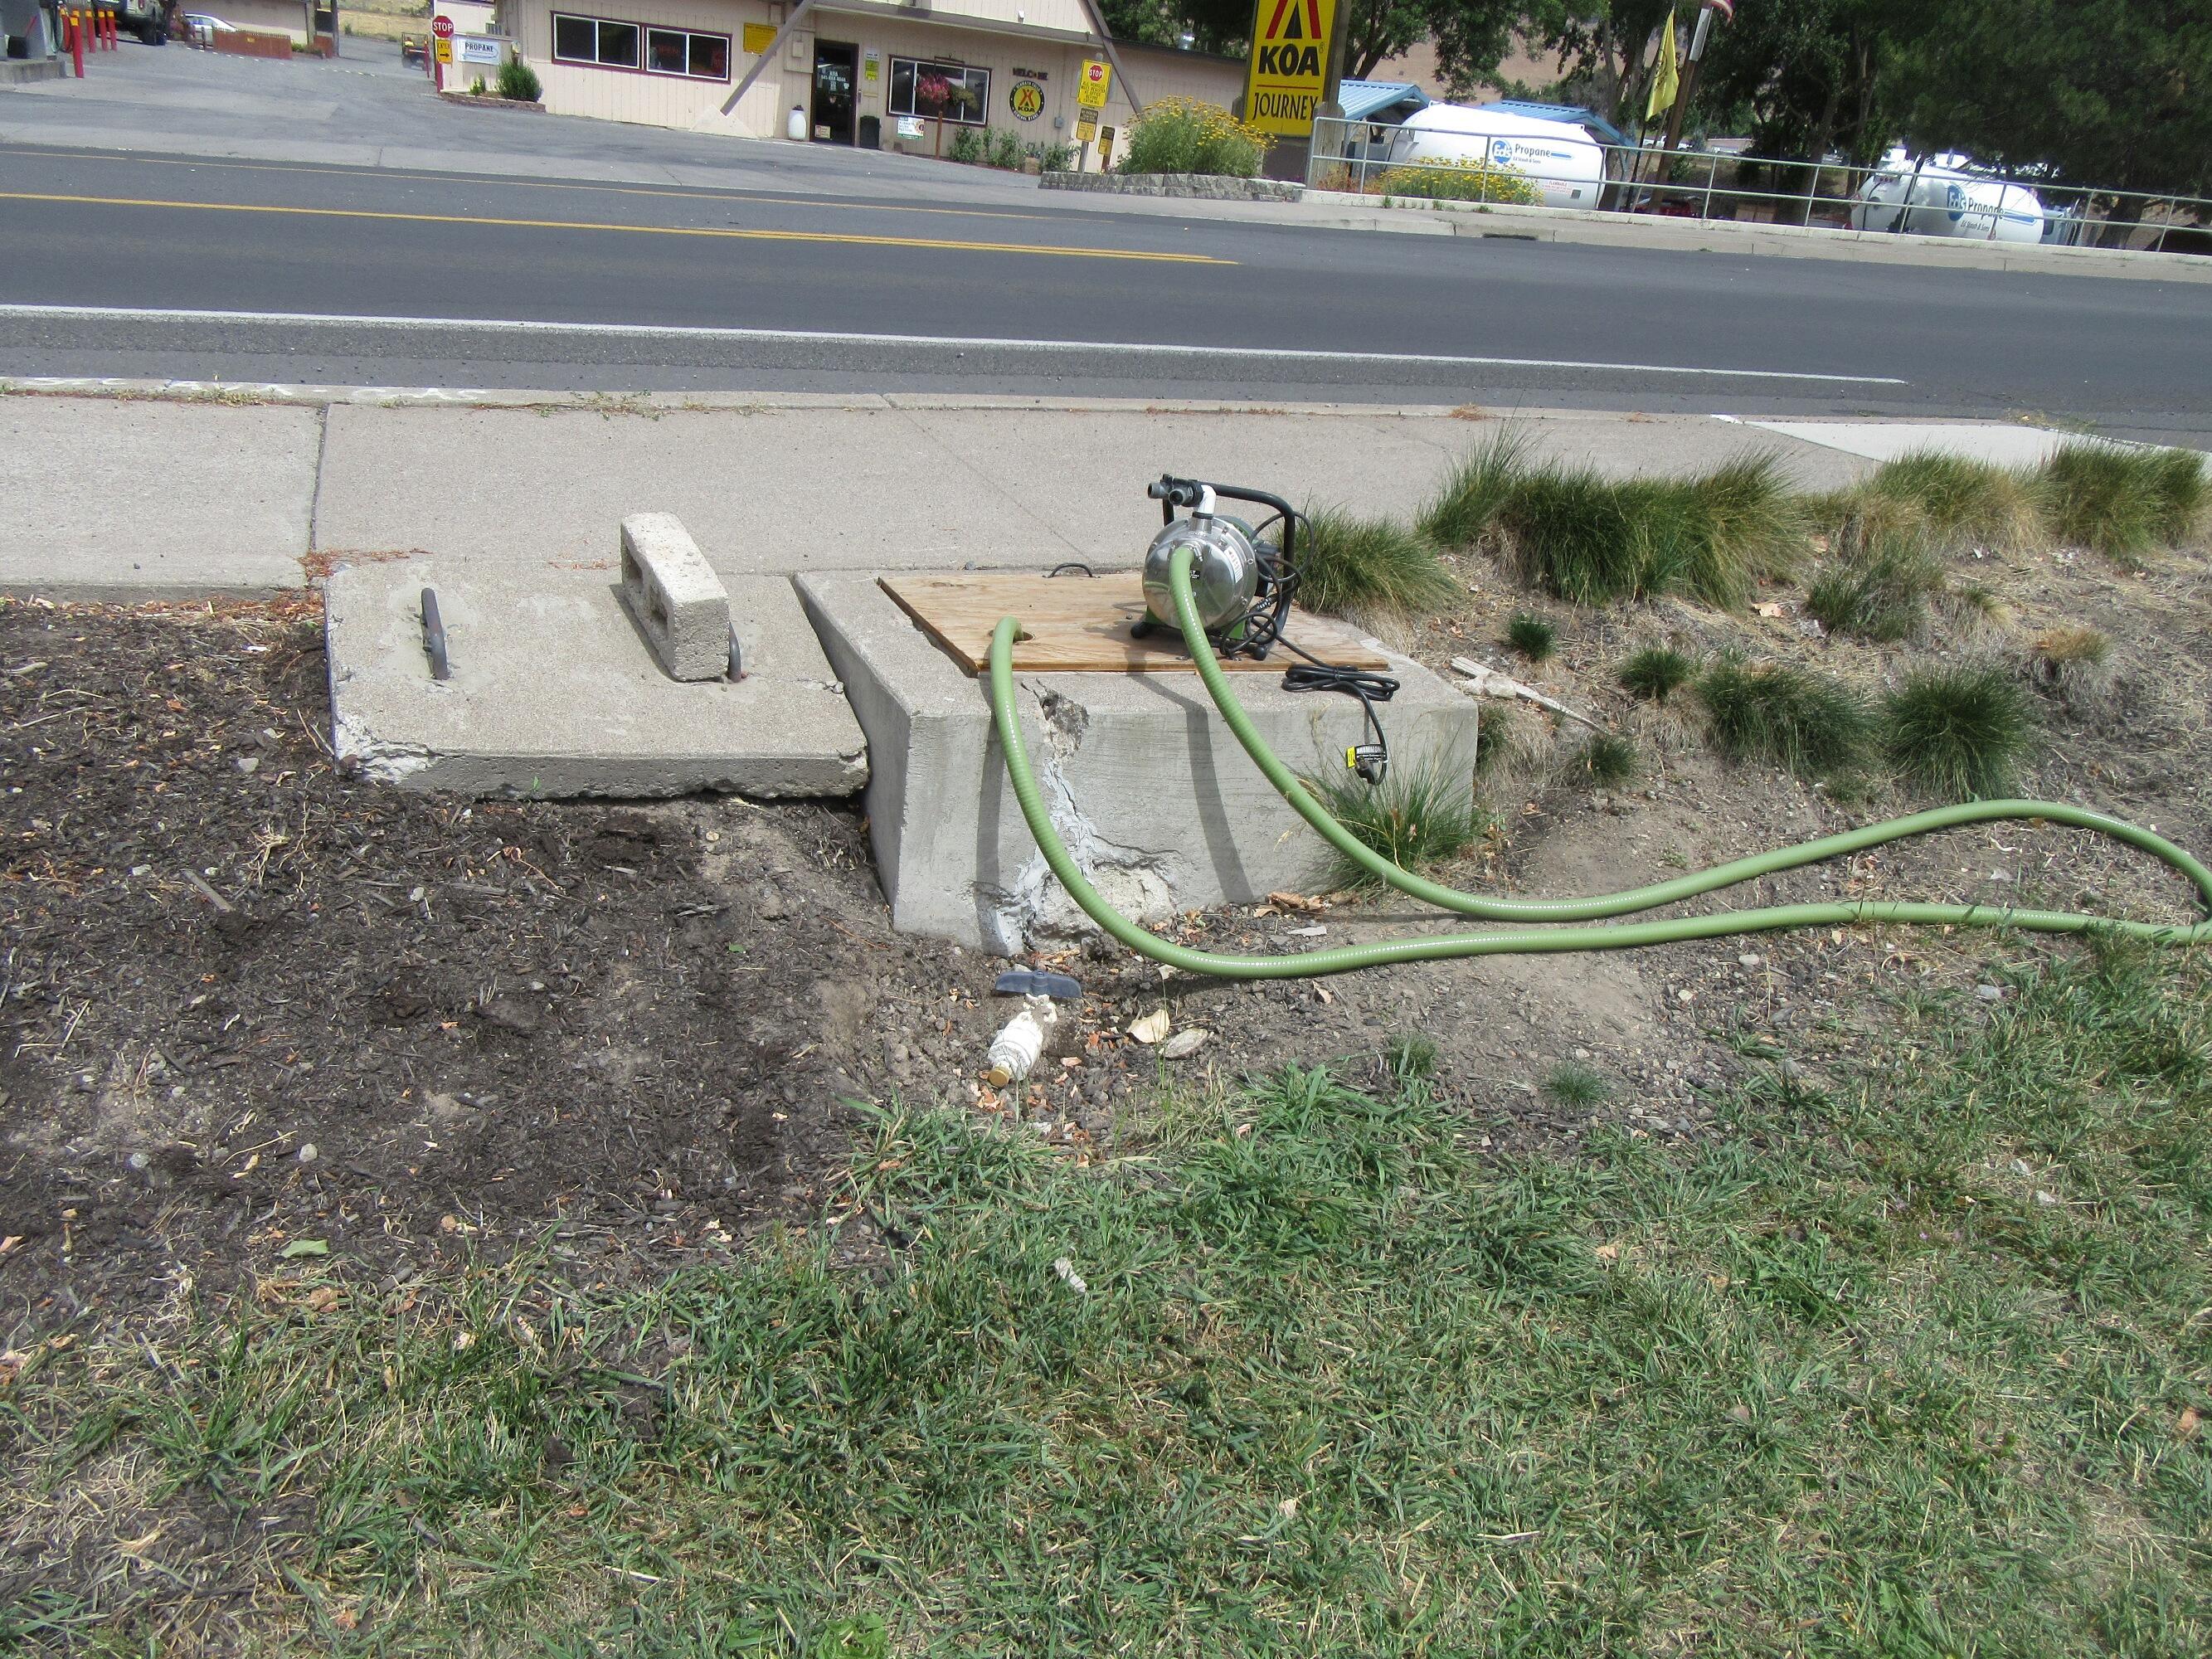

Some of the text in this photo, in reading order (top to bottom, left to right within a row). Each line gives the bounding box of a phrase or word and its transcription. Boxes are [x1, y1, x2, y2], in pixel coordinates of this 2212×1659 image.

[433, 22, 453, 32] STOP
[464, 41, 494, 52] PROPANE
[1257, 43, 1320, 76] KOA
[1089, 69, 1102, 77] STOP
[1252, 92, 1319, 121] JOURNEY
[1514, 144, 1552, 158] Propane
[1949, 192, 2005, 220] Ed's Propane
